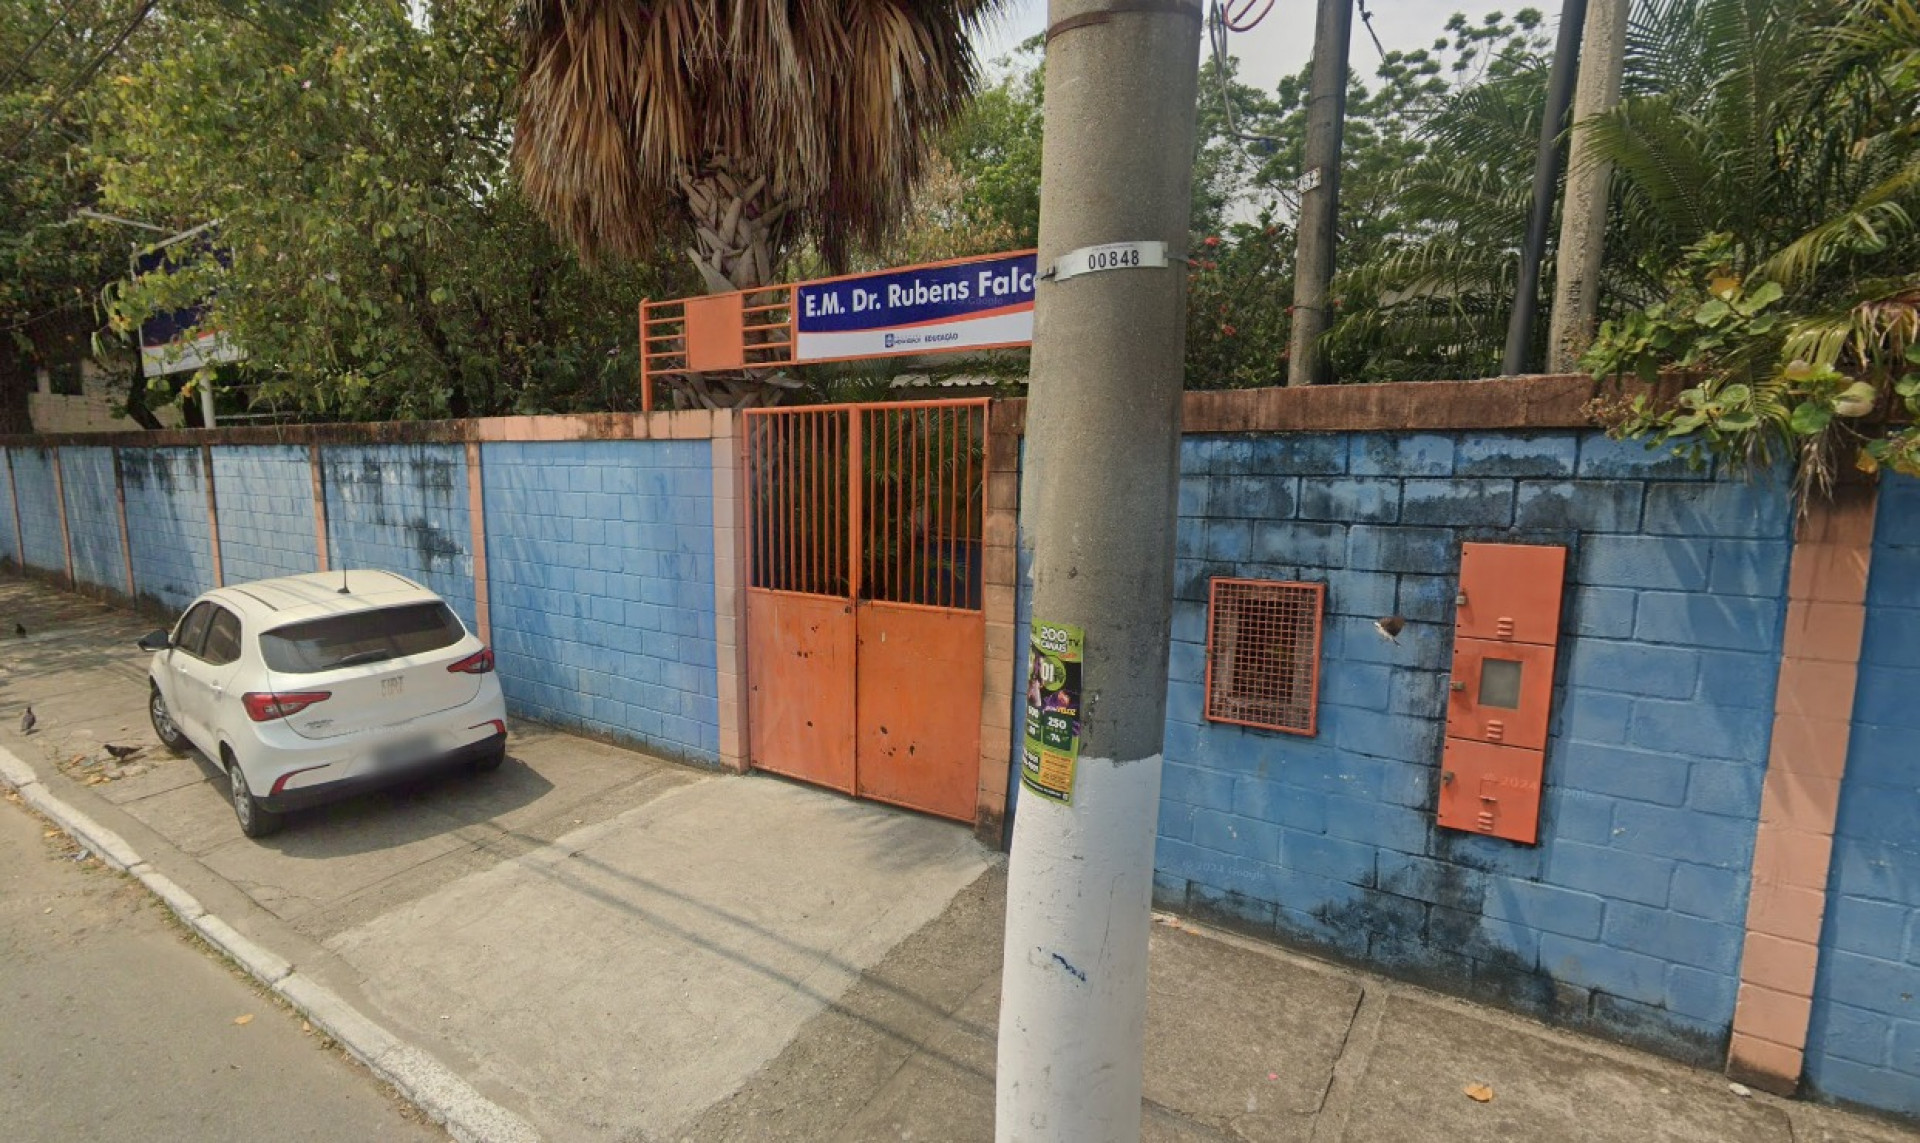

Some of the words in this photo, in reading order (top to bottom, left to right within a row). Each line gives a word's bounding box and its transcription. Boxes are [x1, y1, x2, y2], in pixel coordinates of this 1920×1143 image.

[1088, 250, 1140, 270] 00848
[805, 291, 846, 317] E.M.
[852, 288, 881, 313] Dr.
[887, 279, 970, 308] Rubens
[924, 333, 959, 343] EDUCAÇÃO
[1041, 626, 1067, 642] 200
[381, 675, 404, 697] FIAT
[1047, 716, 1067, 730] 250
